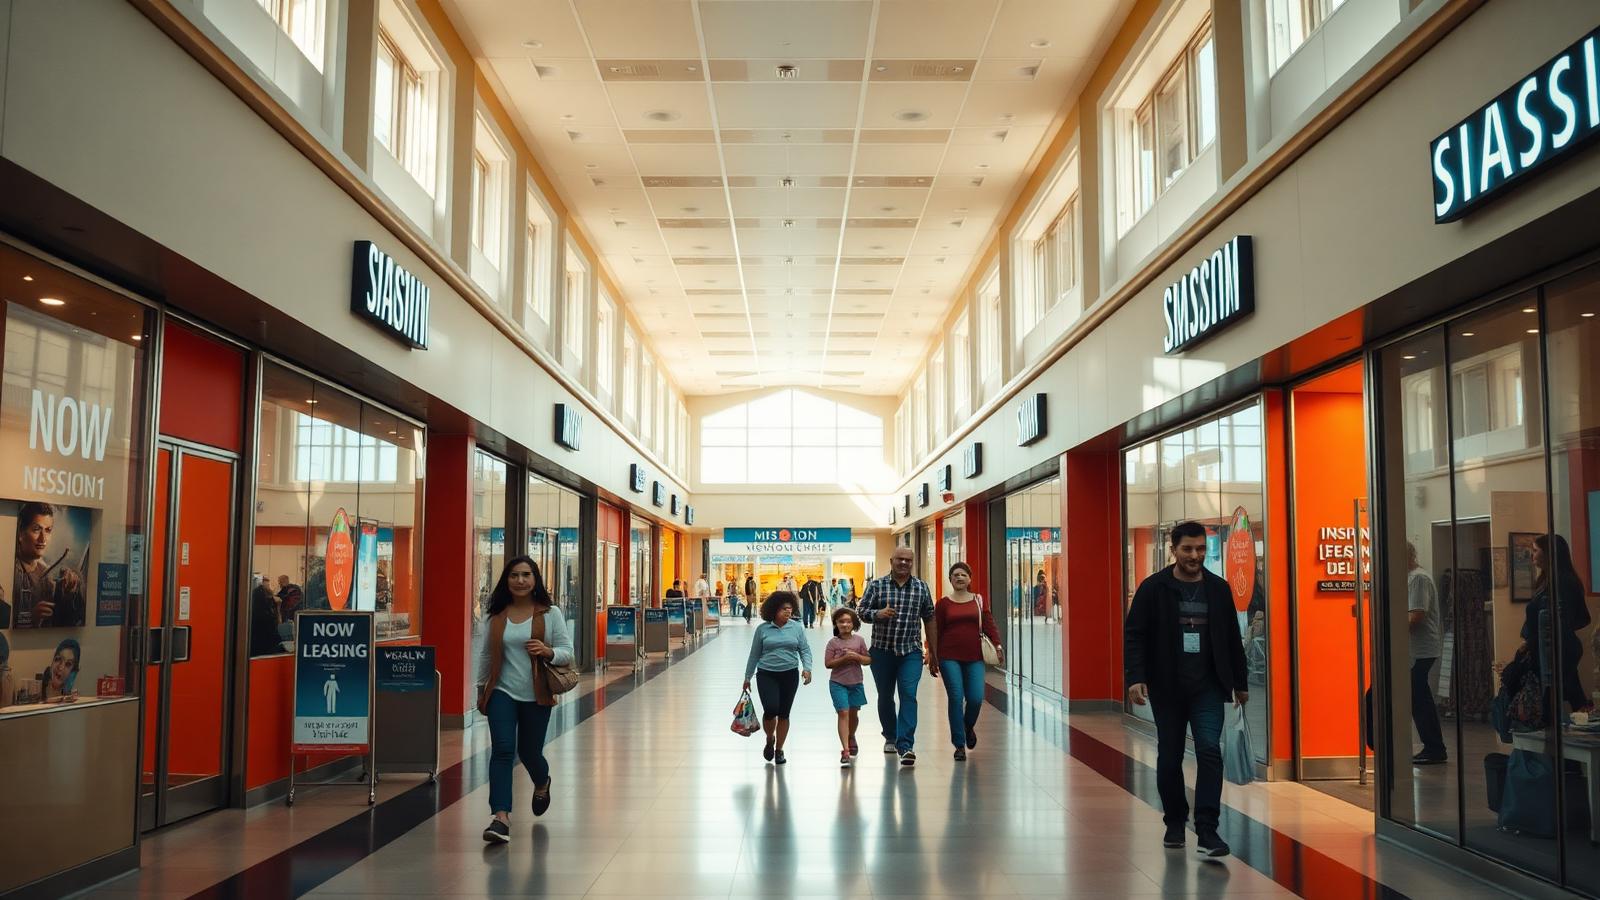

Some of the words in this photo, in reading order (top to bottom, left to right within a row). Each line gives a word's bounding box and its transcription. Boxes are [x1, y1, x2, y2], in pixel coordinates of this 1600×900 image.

[30, 389, 112, 462] NOW
[313, 622, 355, 637] NOW
[303, 644, 367, 658] LEASING
